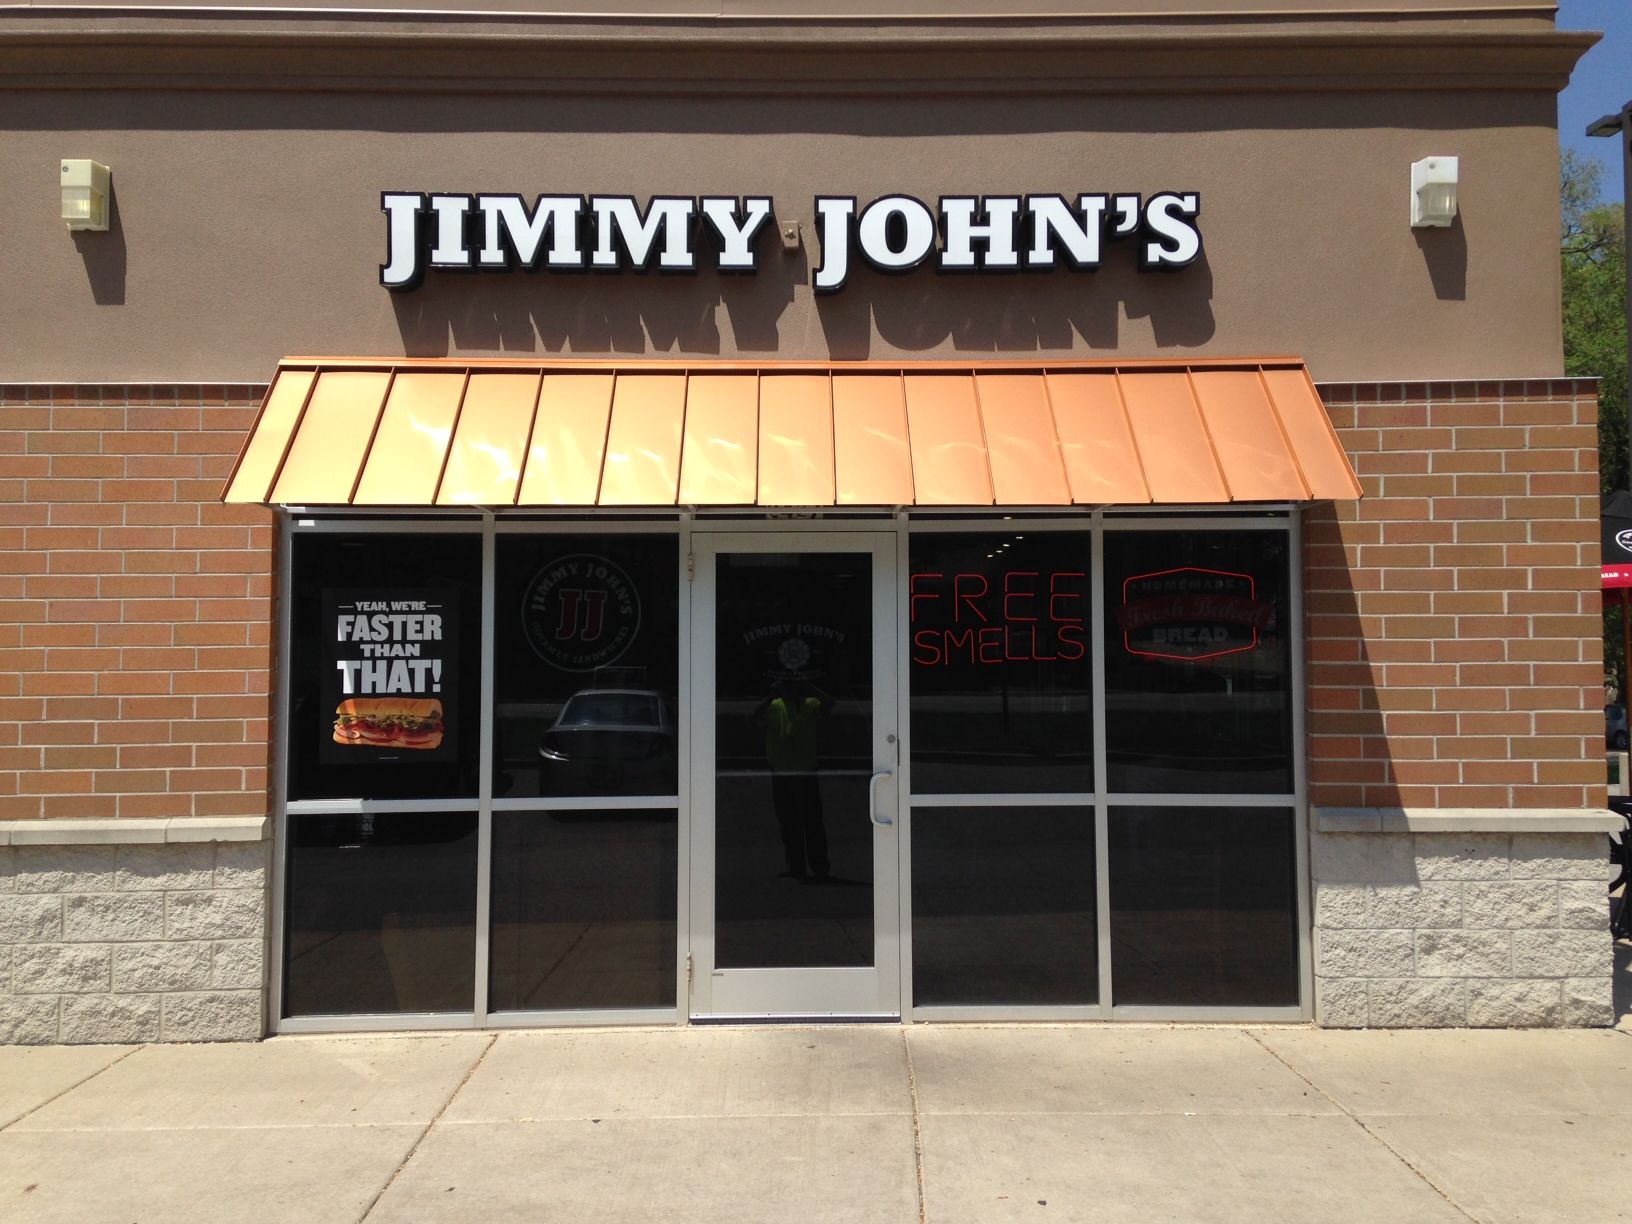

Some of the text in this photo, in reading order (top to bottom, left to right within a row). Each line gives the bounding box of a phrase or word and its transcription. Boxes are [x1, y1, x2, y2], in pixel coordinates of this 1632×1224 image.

[380, 191, 1201, 294] JIMMY JOHN'S
[531, 562, 633, 616] JIMMY JOHN'S
[910, 571, 1086, 623] FREE
[1141, 578, 1235, 591] HOMEMADE
[355, 601, 426, 612] YEAH, WE'RE
[337, 614, 442, 641] FASTER
[743, 623, 792, 645] JIMMY
[1152, 627, 1229, 643] BREAD
[360, 643, 420, 657] THAN
[913, 624, 1085, 665] SMELLS
[337, 659, 442, 694] THAT!
